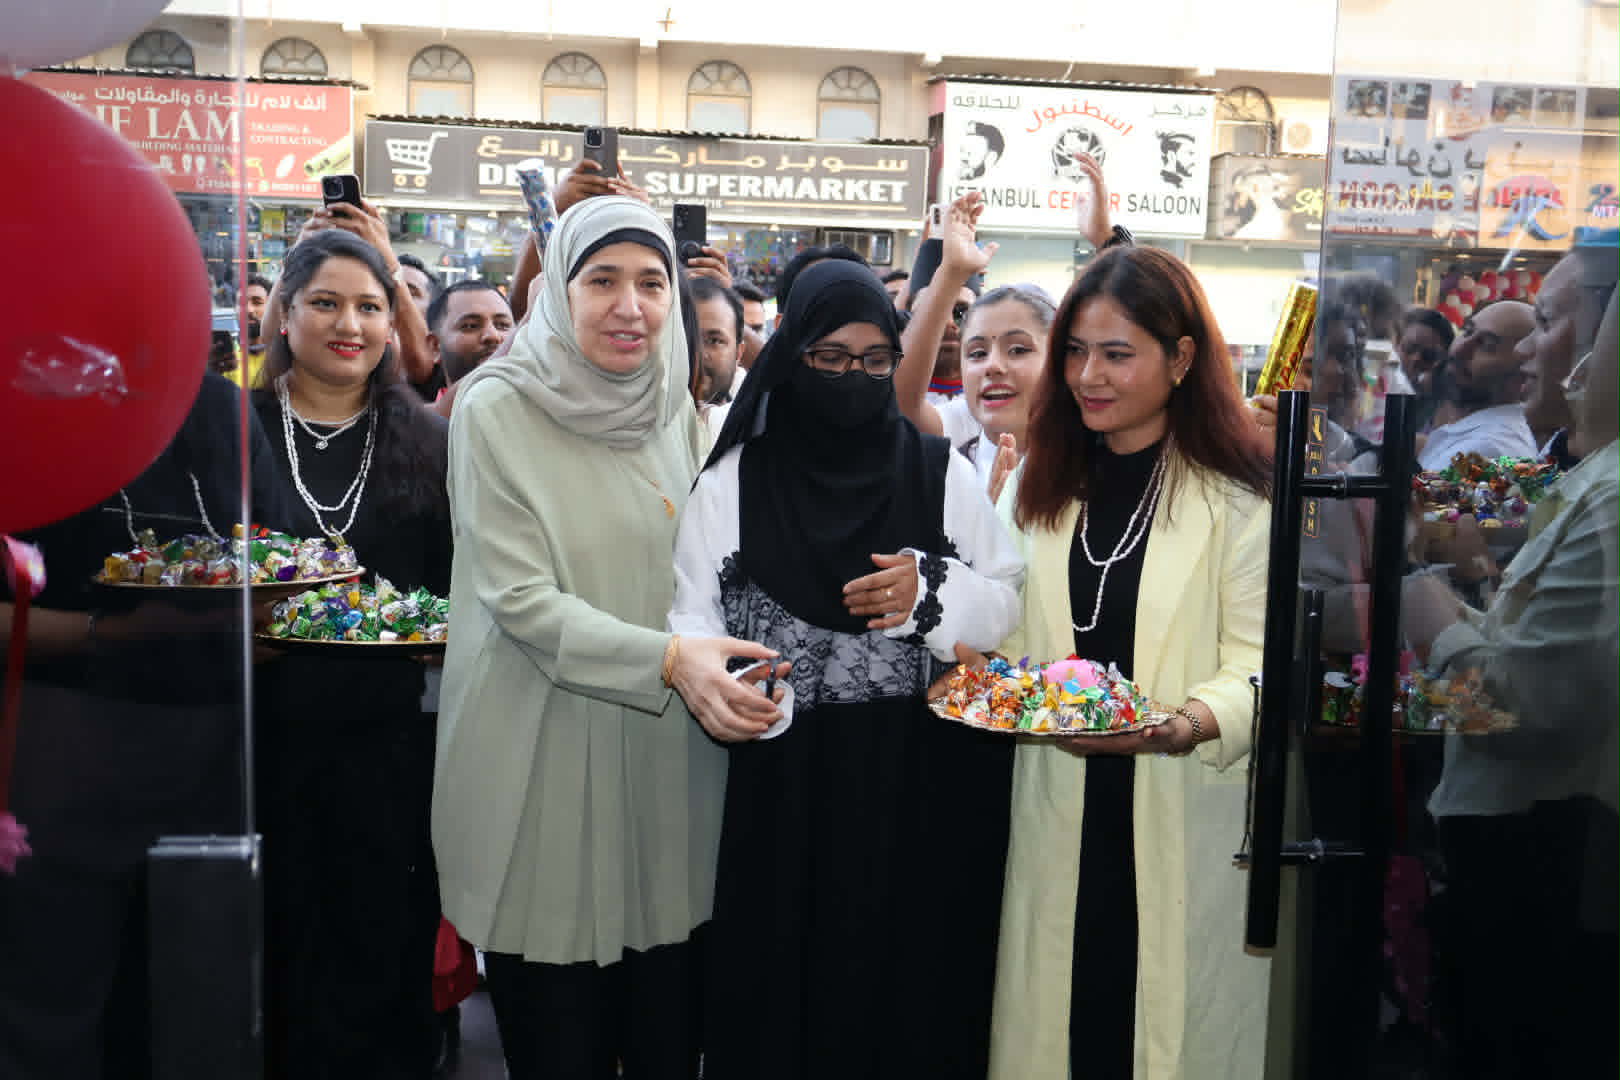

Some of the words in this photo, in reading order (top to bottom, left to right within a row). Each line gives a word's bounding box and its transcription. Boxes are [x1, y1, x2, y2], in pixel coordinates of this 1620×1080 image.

[147, 107, 240, 142] LAM
[644, 171, 909, 203] SUPERMARKET
[948, 186, 1041, 209] ISANBUL
[1047, 190, 1121, 212] CER
[1127, 193, 1200, 215] SALOON
